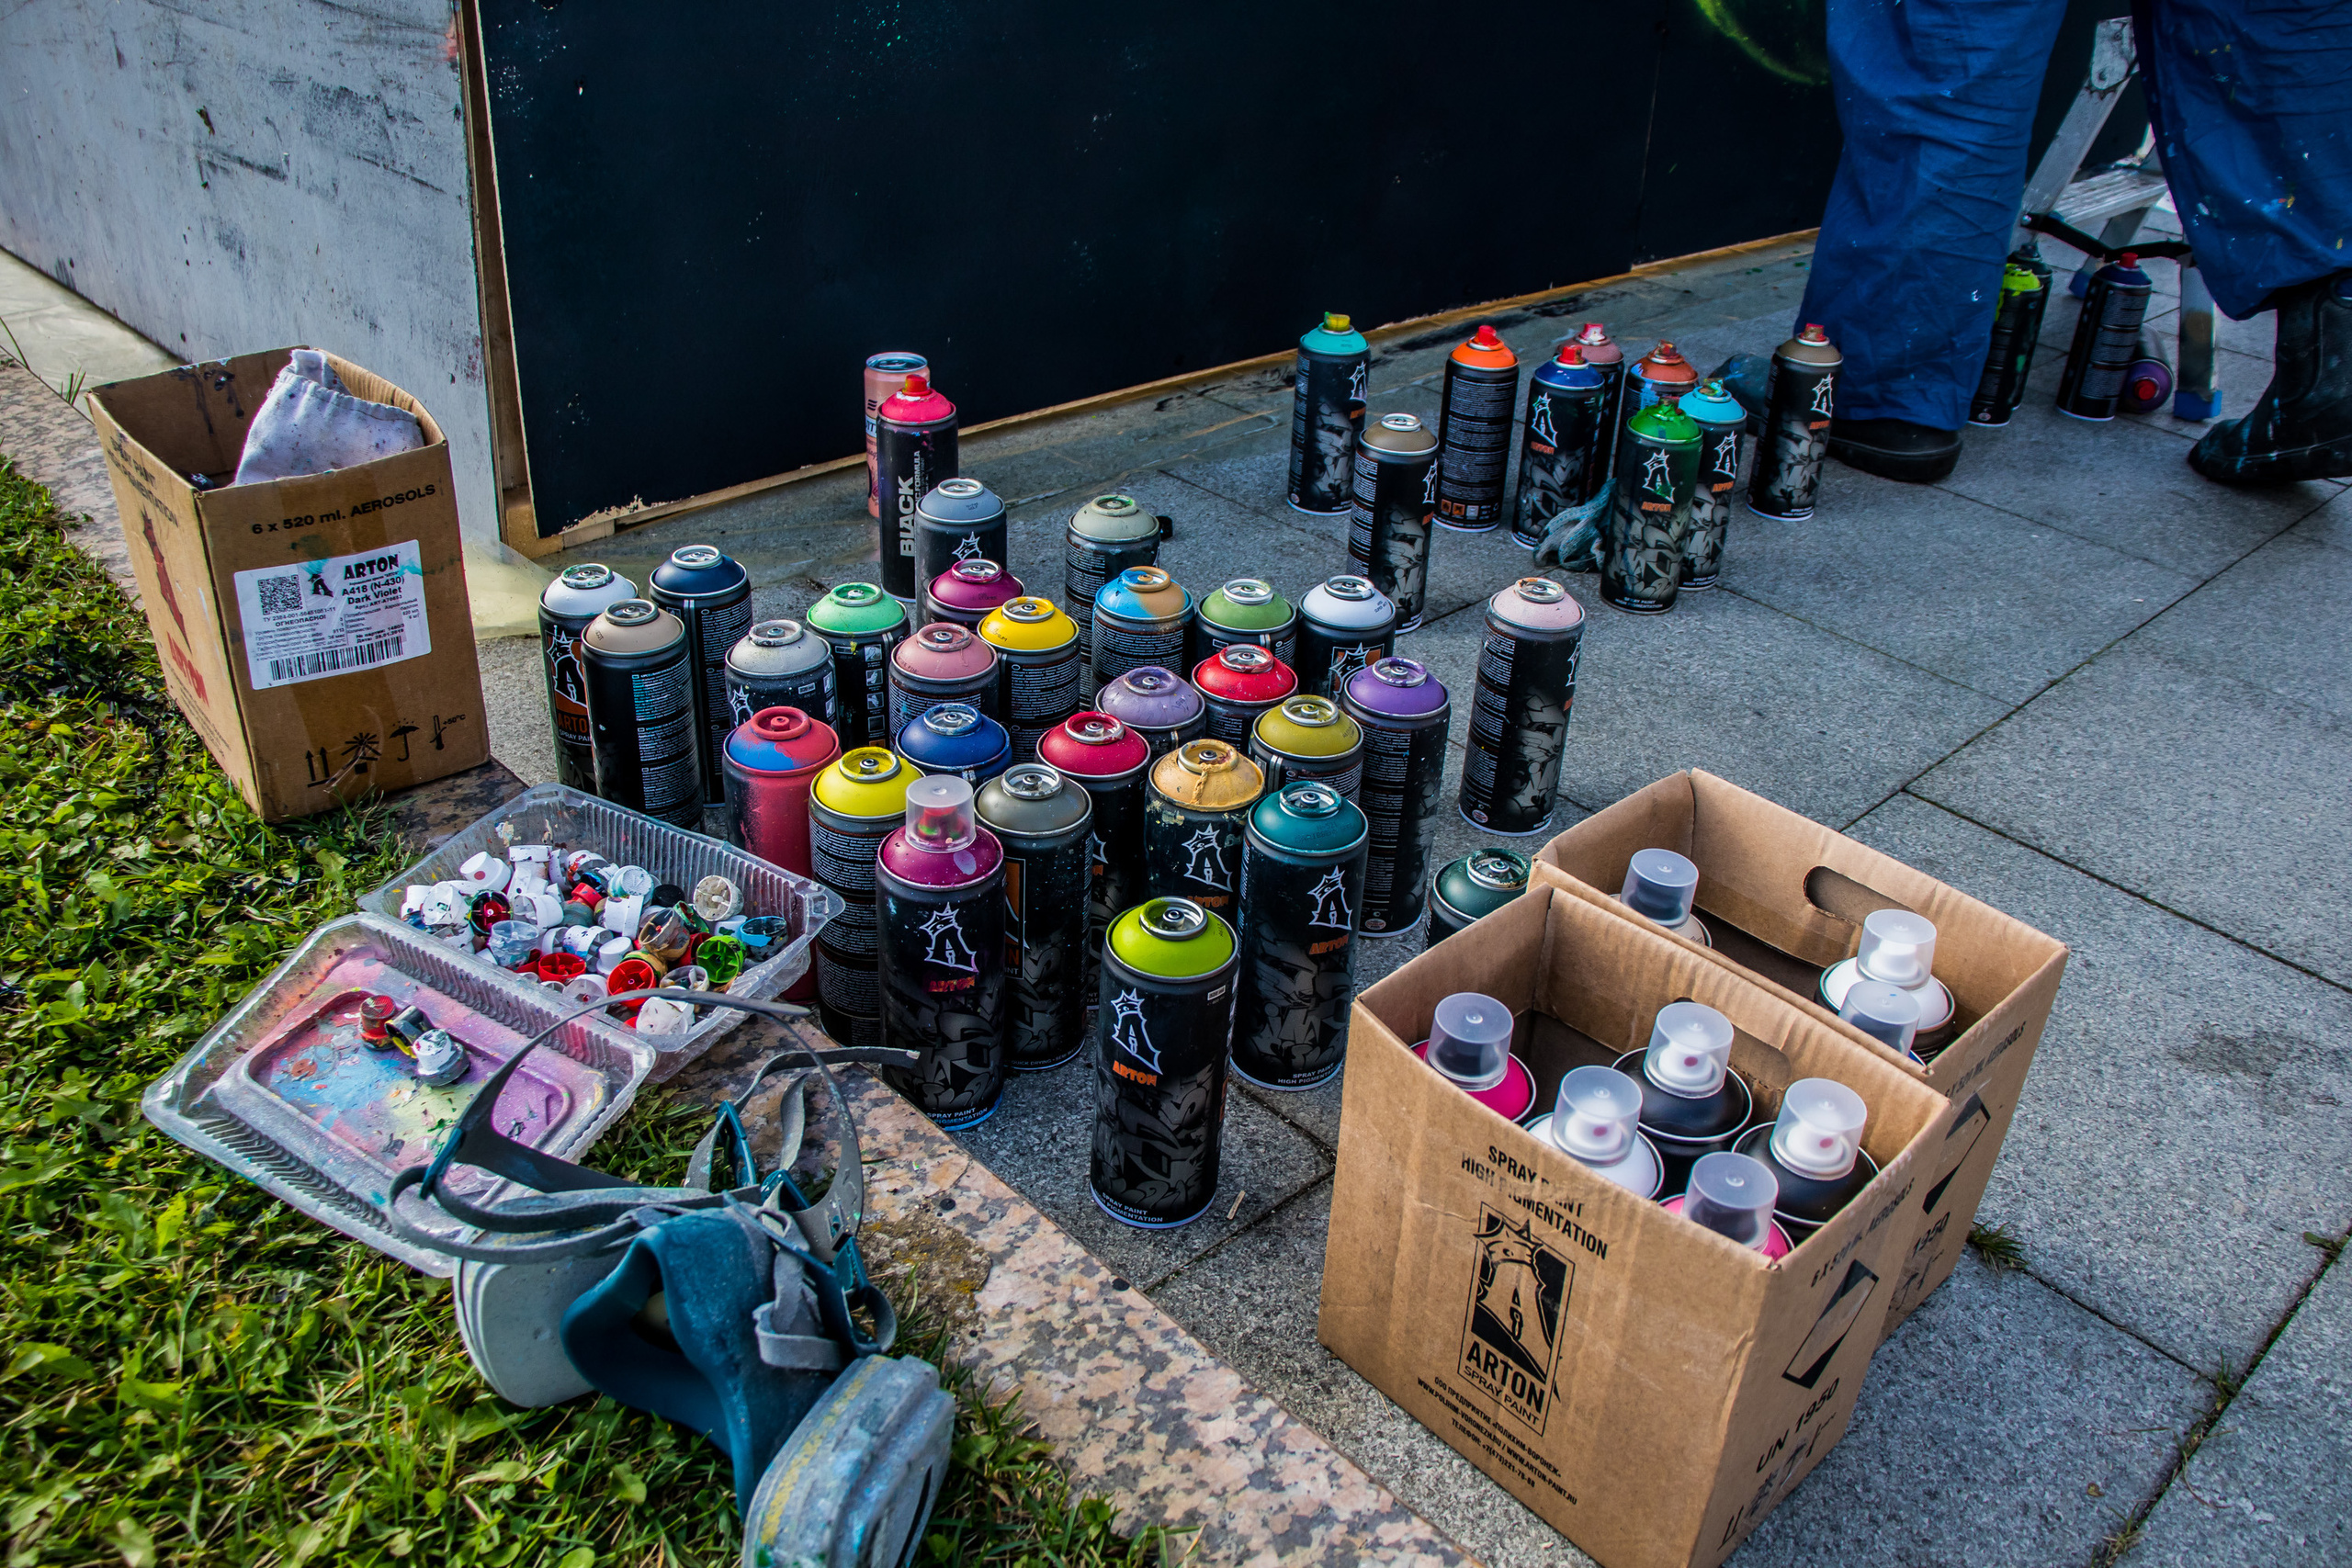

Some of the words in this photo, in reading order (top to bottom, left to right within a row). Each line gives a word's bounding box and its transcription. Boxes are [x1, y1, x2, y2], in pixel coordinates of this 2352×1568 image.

[252, 523, 263, 535] 6
[283, 514, 314, 529] 520
[320, 509, 346, 524] ml.
[350, 484, 436, 517] AEROSOLS
[898, 475, 916, 558] BLACK
[1641, 502, 1672, 513] ARTON
[345, 554, 399, 580] ARTON
[342, 584, 368, 596] A418
[370, 576, 405, 592] (N-430)
[347, 594, 371, 604] Dark
[373, 586, 402, 599] Violet
[558, 712, 588, 734] ARTO
[559, 728, 577, 740] SPRAY
[1187, 895, 1229, 908] RTON
[1309, 934, 1349, 955] ARTON
[1005, 967, 1019, 976] INT
[928, 976, 976, 992] ARTON
[1113, 1060, 1158, 1087] ARTON
[1293, 1070, 1317, 1079] SPRAY
[1317, 1062, 1335, 1077] PAINT
[933, 1107, 988, 1124] PIGMENTATION
[954, 1107, 977, 1117] PAINT
[1461, 1152, 1496, 1188] HIGH
[1488, 1145, 1537, 1183] SPRAY
[1102, 1191, 1123, 1208] SPRAY
[1124, 1204, 1148, 1215] PAINT
[1106, 1201, 1163, 1223] PIGMENTATION
[1866, 1177, 1915, 1236] AEROSOLS
[1466, 1340, 1544, 1414] ARTON
[1447, 1385, 1492, 1424] ПРЕДПРИЯТИЕ
[1464, 1365, 1502, 1396] SPRAY
[1504, 1393, 1540, 1425] PAINT
[1756, 1428, 1790, 1473] UN
[1795, 1377, 1840, 1433] 1950
[1418, 1377, 1502, 1449] WWW.POLIHIM-VORONEZH.RU
[1506, 1445, 1577, 1506] WWW.ARTON-PAINT.RU
